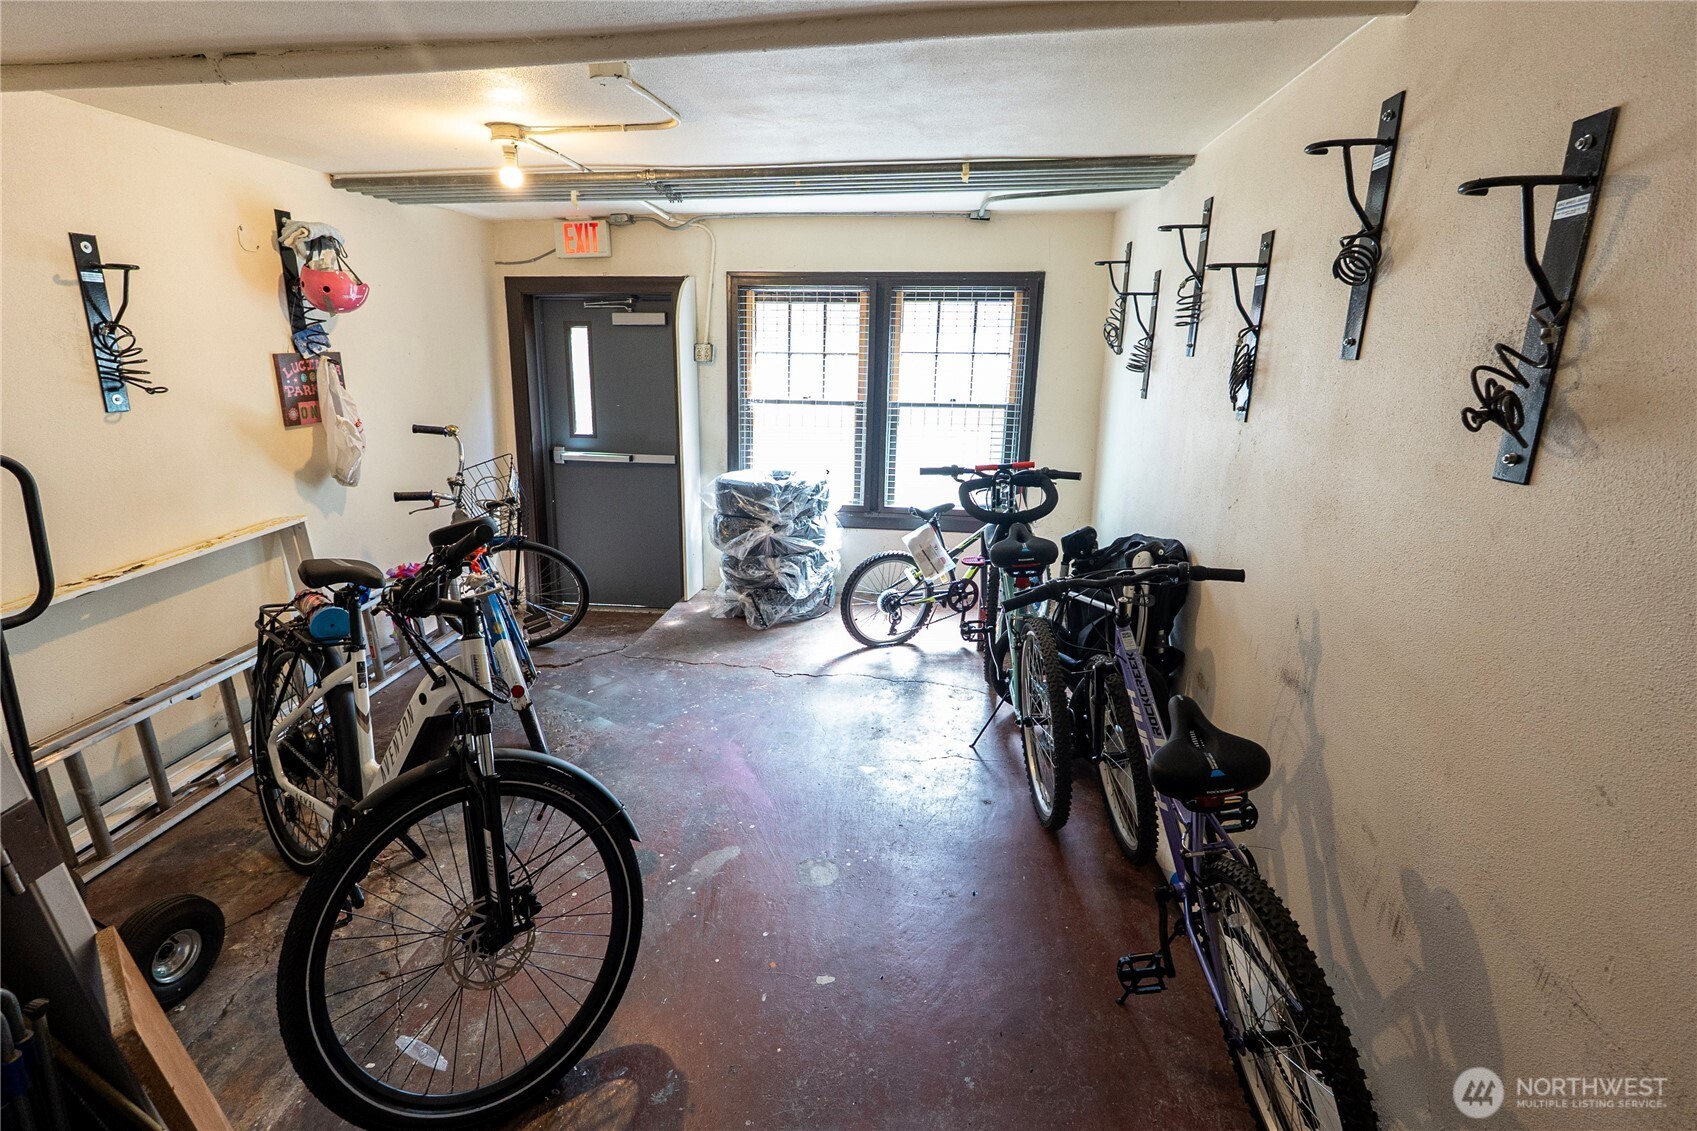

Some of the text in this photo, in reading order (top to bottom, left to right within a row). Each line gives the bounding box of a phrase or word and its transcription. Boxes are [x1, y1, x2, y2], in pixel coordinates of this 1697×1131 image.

[563, 223, 598, 254] EXIT
[1126, 651, 1163, 737] ROCKCREEK
[380, 704, 414, 784] AVENTON
[543, 782, 576, 799] KENDA
